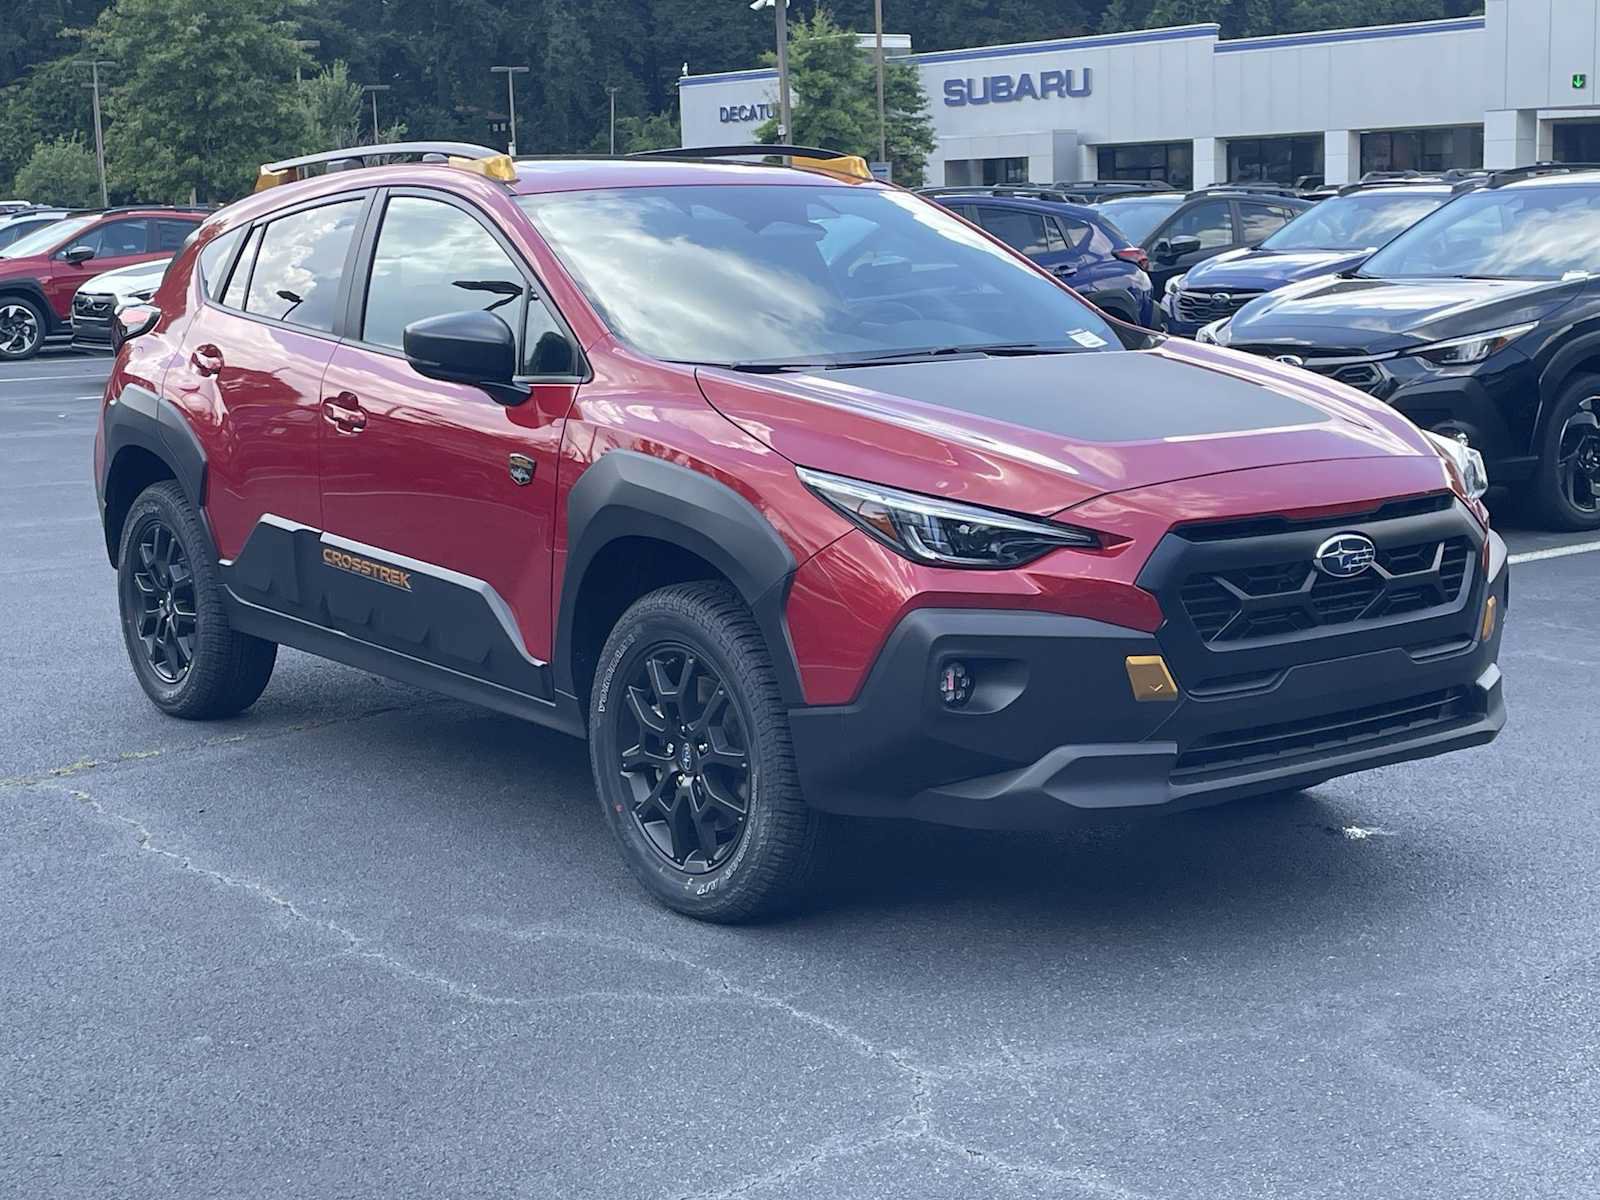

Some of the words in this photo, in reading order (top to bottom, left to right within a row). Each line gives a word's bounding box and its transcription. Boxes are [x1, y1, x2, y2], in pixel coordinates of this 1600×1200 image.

[943, 67, 1093, 107] SUBARU
[719, 103, 777, 123] DECATU
[322, 548, 411, 589] CROSSTREK
